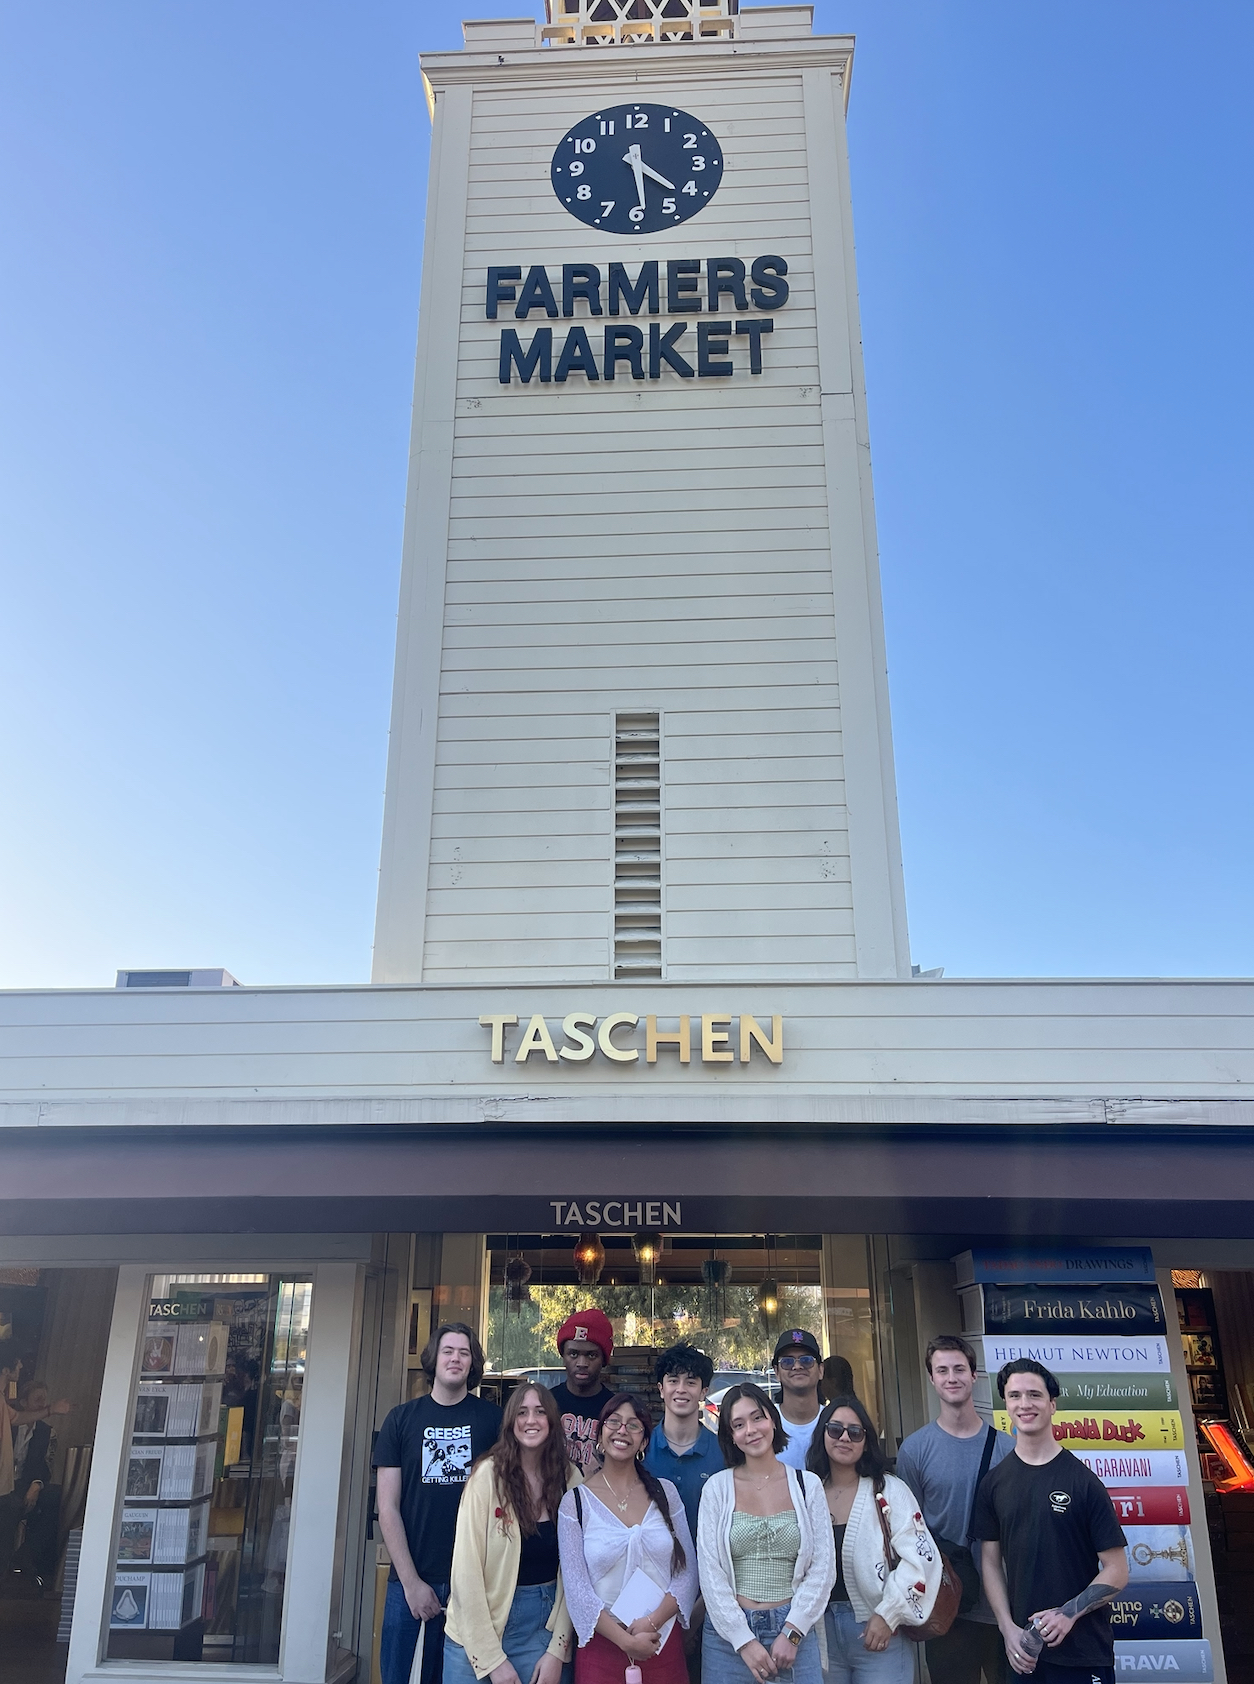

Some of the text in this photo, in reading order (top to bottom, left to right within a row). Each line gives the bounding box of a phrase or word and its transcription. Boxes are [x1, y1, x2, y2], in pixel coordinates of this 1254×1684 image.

[600, 120, 615, 136] 11
[626, 113, 649, 130] 12
[664, 117, 671, 133] 1
[574, 138, 597, 154] 10
[683, 133, 698, 149] 2
[569, 161, 585, 177] 9
[692, 155, 706, 172] 3
[576, 184, 592, 201] 8
[682, 180, 698, 196] 4
[600, 201, 616, 218] 7
[629, 206, 644, 222] 6
[662, 198, 676, 214] 5
[485, 254, 790, 319] FARMERS
[499, 318, 774, 384] MARKET
[478, 1011, 784, 1065] TASCHEN
[550, 1201, 682, 1227] TASCHEN
[1065, 1258, 1134, 1270] DRAWINGS
[150, 1303, 206, 1316] TASCHEN
[1023, 1300, 1075, 1319] Frida
[1080, 1299, 1136, 1320] Kahlo
[1150, 1296, 1160, 1323] TASCHEN
[574, 1326, 588, 1341] E
[994, 1347, 1148, 1361] HELMUT NEWTON
[1077, 1384, 1094, 1400] My
[1096, 1384, 1148, 1397] Education
[1164, 1380, 1172, 1402] TASCHEN
[423, 1425, 471, 1440] GEESE
[560, 1413, 598, 1439] OVE
[1052, 1418, 1101, 1441] onald
[1103, 1419, 1146, 1443] Duck
[1095, 1458, 1152, 1477] GARAVANI
[1118, 1496, 1145, 1517] ri
[1176, 1494, 1184, 1517] TASCHEN
[1187, 1596, 1195, 1625] TASCHEN
